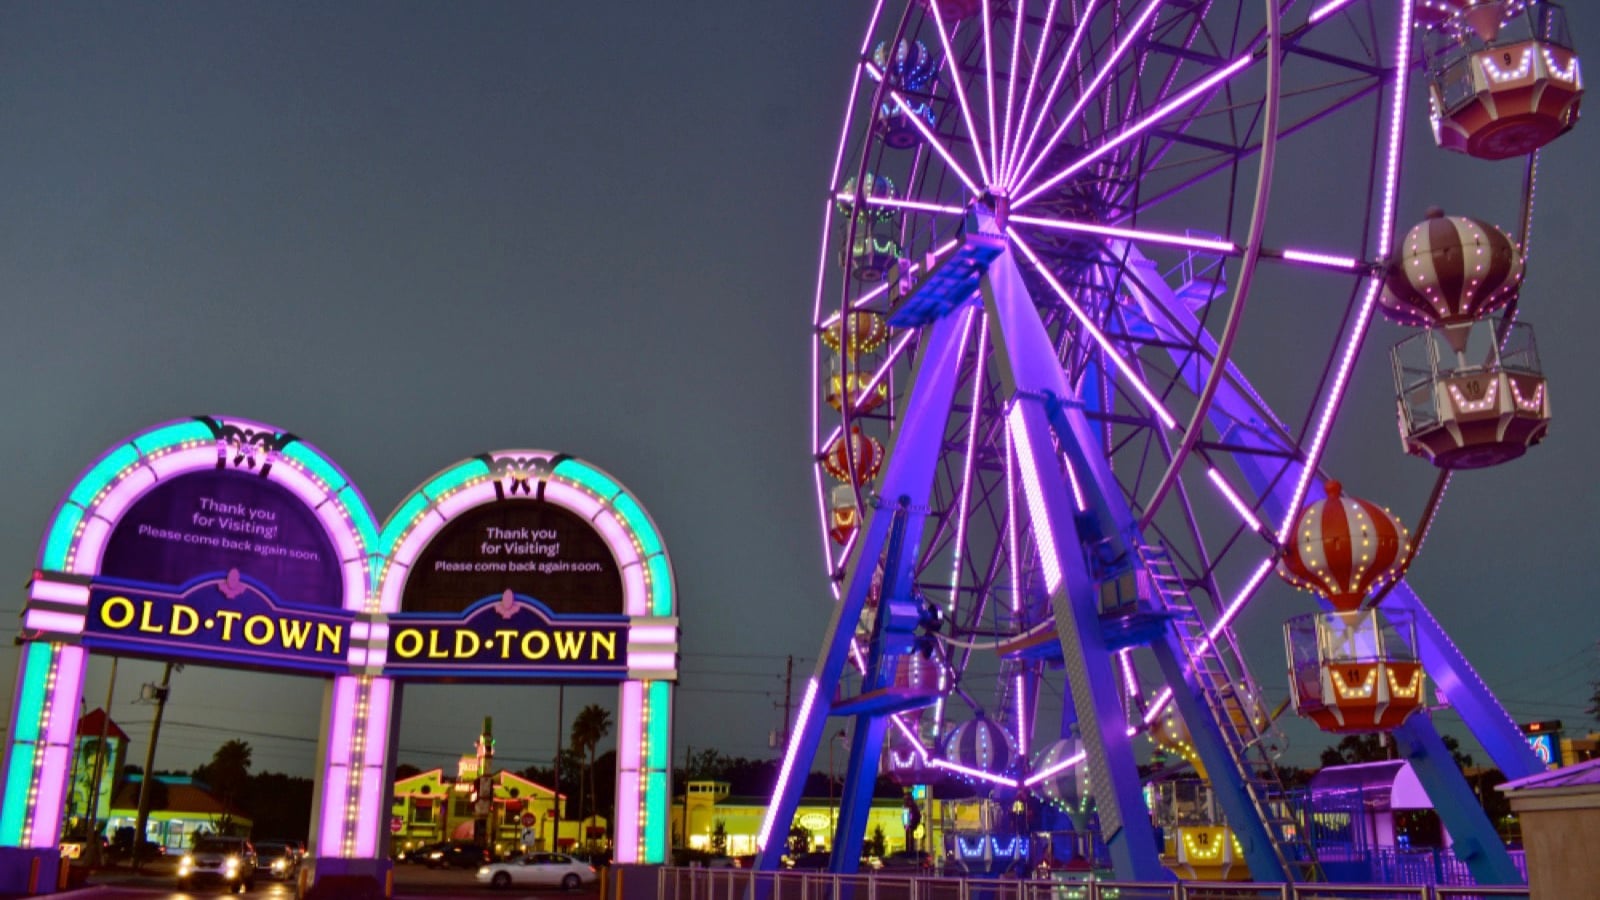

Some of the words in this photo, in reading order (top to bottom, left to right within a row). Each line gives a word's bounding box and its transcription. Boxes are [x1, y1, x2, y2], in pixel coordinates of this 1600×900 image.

[1503, 52, 1512, 66] 9
[1466, 379, 1480, 395] 10
[200, 497, 246, 516] Thank
[249, 506, 276, 521] you
[192, 512, 215, 527] for
[218, 516, 278, 538] Visiting!
[486, 527, 529, 539] Thank
[532, 529, 557, 542] you
[138, 524, 182, 541] Please
[183, 533, 220, 547] come
[222, 536, 251, 552] back
[254, 543, 287, 558] again
[289, 547, 321, 562] soon.
[481, 541, 501, 554] for
[503, 541, 560, 557] Visiting!
[434, 561, 473, 572] Please
[474, 563, 507, 572] come
[508, 561, 536, 572] back
[538, 562, 570, 574] again
[571, 563, 602, 572] soon.
[1347, 669, 1360, 682] 11
[1198, 832, 1209, 845] 12
